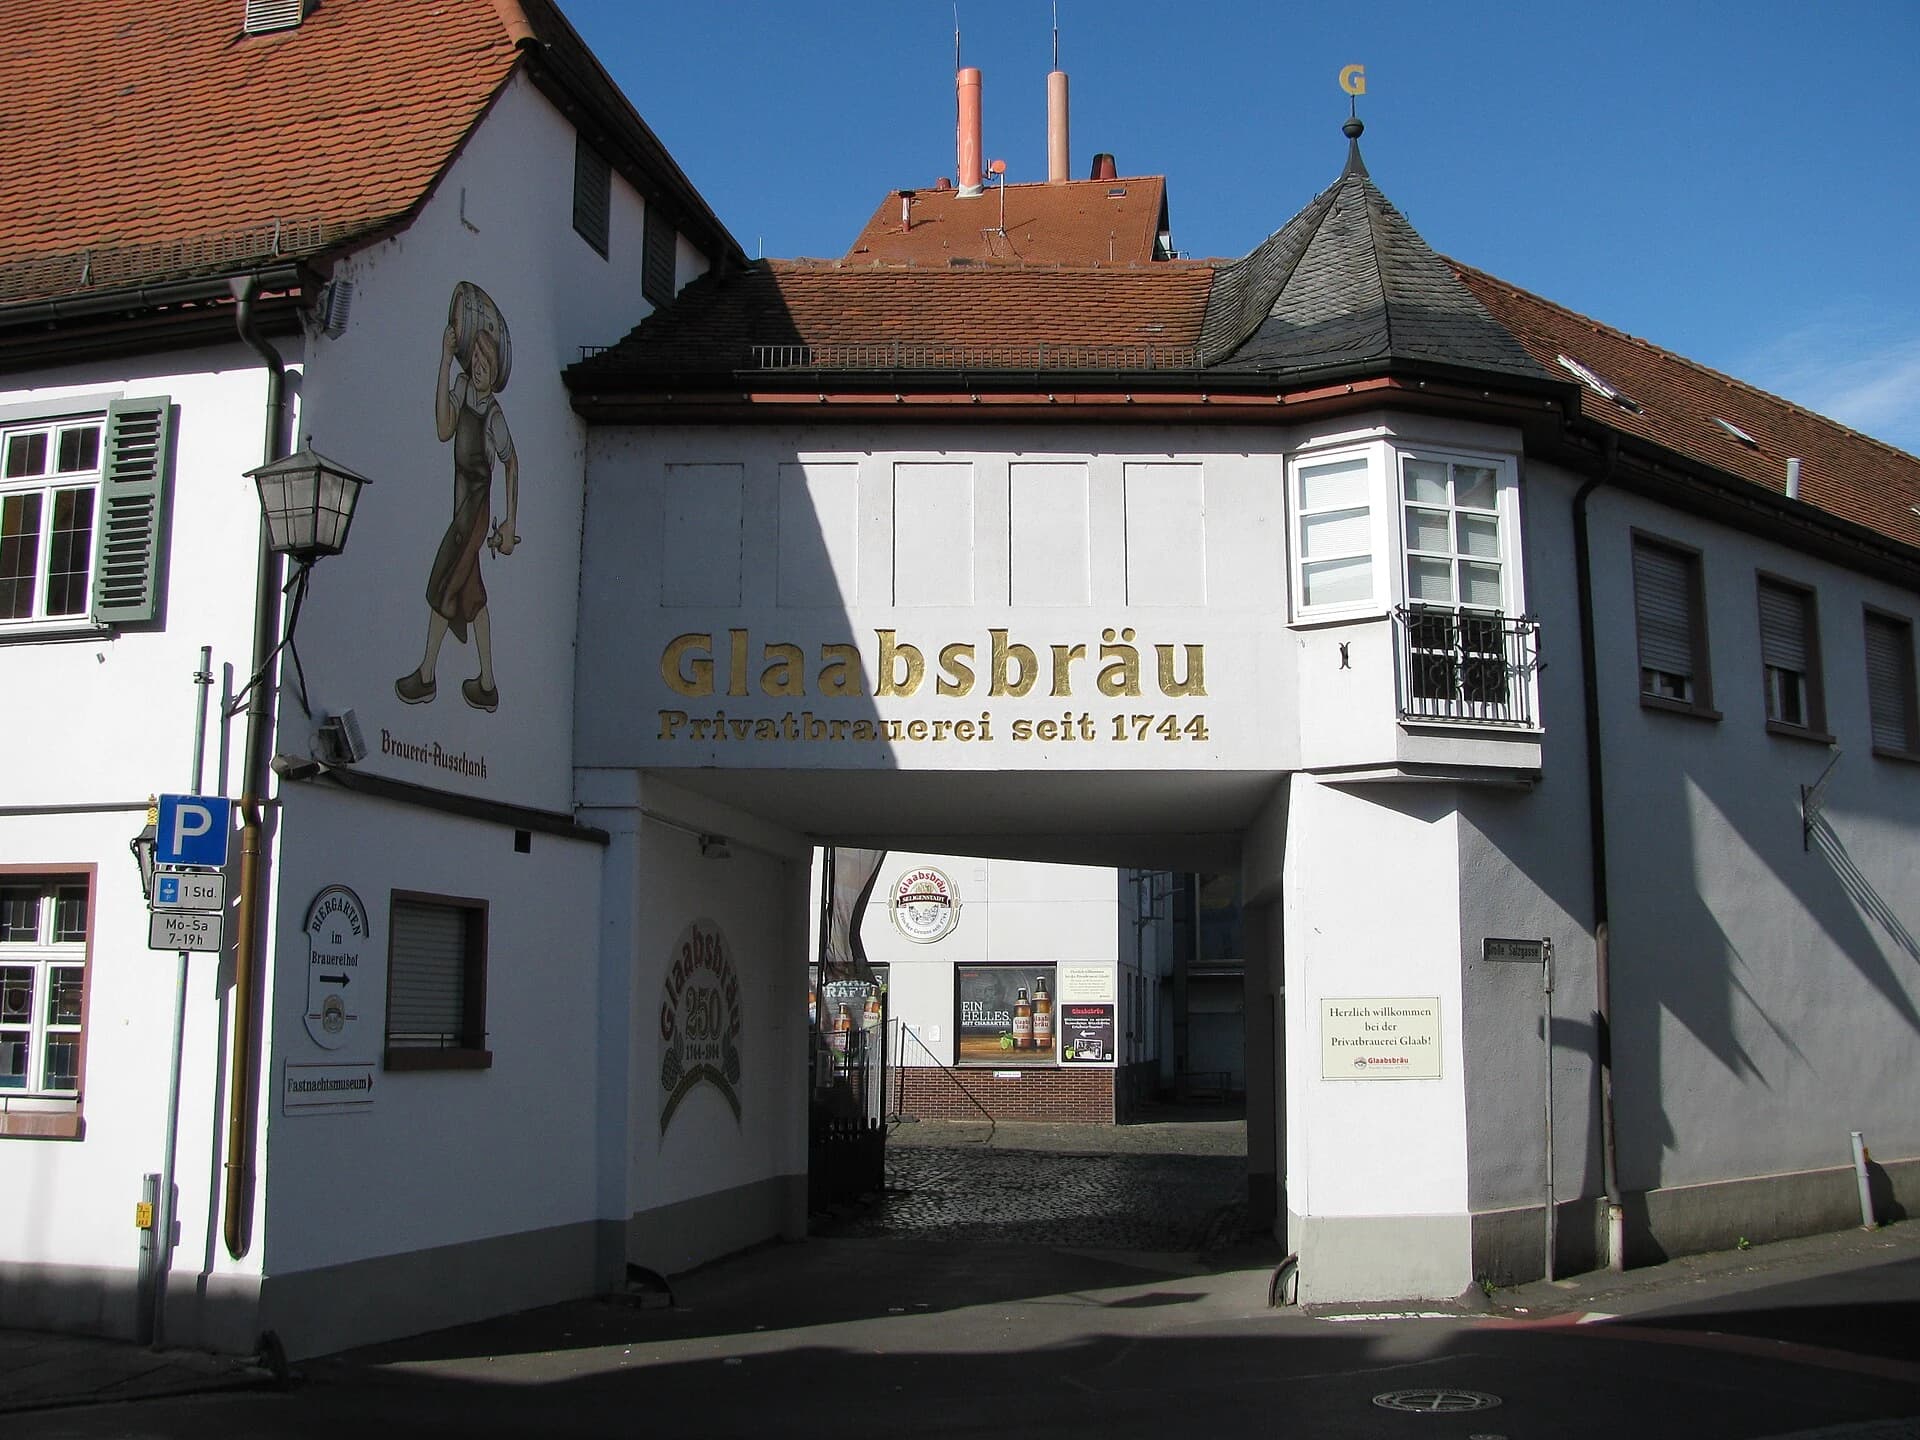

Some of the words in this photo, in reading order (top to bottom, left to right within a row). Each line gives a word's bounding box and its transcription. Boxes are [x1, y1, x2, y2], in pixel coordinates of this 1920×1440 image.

[1339, 64, 1365, 95] G
[661, 627, 1208, 698] Glaabsbräu
[657, 710, 994, 742] Privatbrauerei
[1012, 711, 1096, 742] seit
[1112, 713, 1209, 742] 1744
[381, 728, 487, 779] Brauerei-Ausschank
[172, 804, 213, 856] P
[900, 872, 947, 894] Glaabsbräu
[184, 886, 189, 897] 1
[193, 886, 217, 898] Std.
[166, 918, 208, 931] Mo-Sa
[312, 897, 361, 937] BIERGARTEN
[331, 930, 341, 945] im
[311, 951, 359, 967] Brauereihof
[822, 985, 869, 998] RAFT
[685, 985, 722, 1041] 250
[962, 1001, 983, 1011] EIN
[1330, 1008, 1371, 1017] Herzlich
[1372, 1007, 1432, 1016] willkommen
[1364, 1022, 1379, 1031] bei
[1381, 1022, 1397, 1031] der
[1331, 1037, 1397, 1046] Privatbrauerei
[1399, 1036, 1431, 1046] Glaab!
[1368, 1056, 1409, 1064] Glaabsbräu
[287, 1076, 367, 1092] Fastnachtsmuseum
